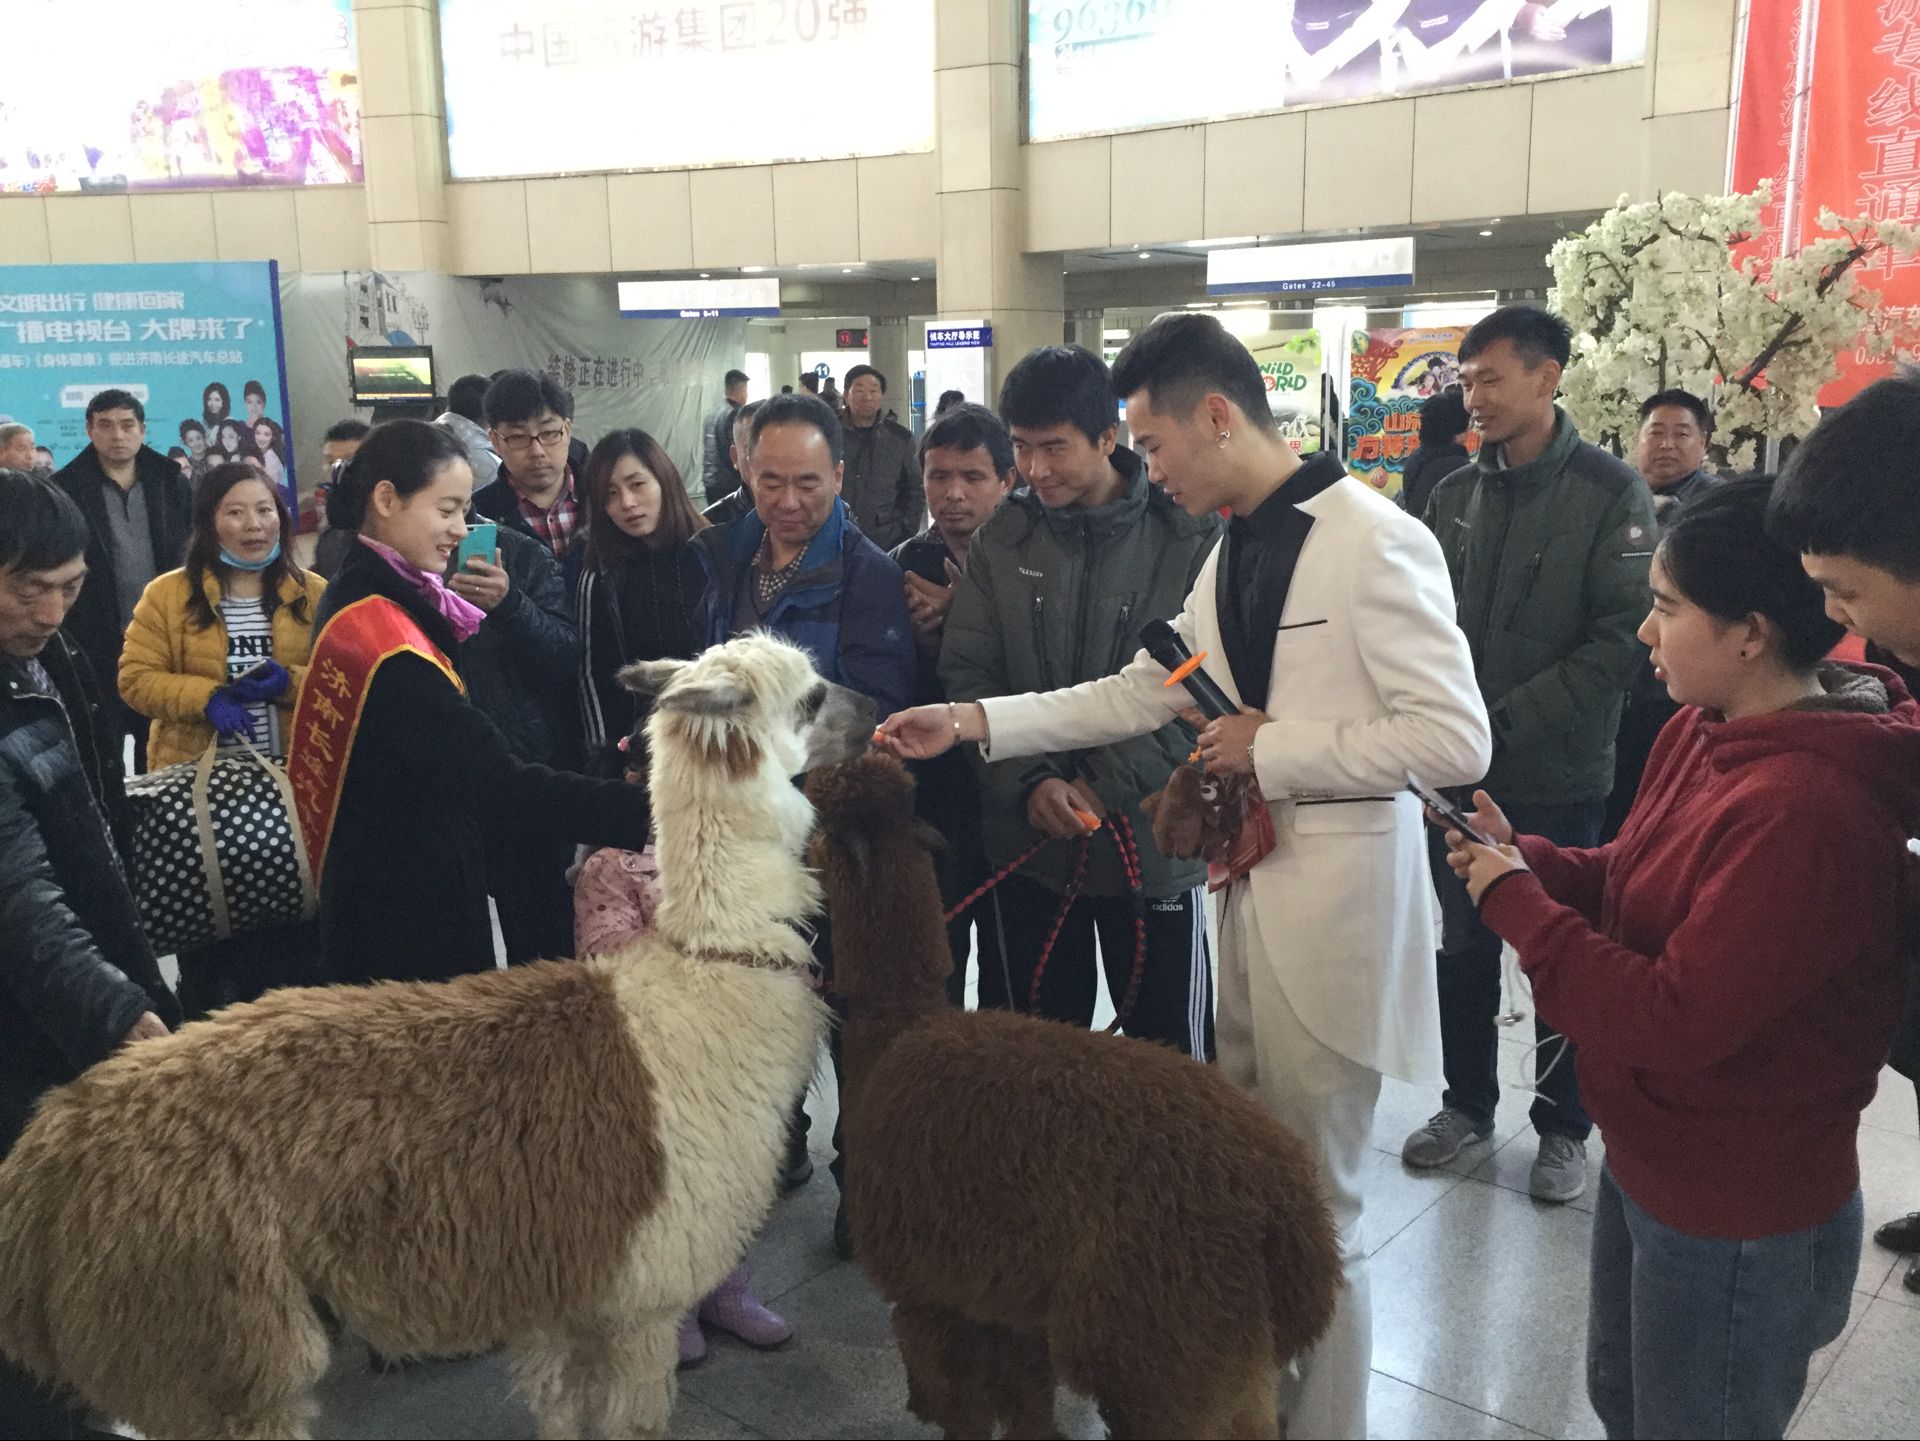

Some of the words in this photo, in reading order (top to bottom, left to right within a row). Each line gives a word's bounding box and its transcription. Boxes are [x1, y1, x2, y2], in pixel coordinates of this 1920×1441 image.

[1282, 282, 1306, 290] Gates
[817, 366, 828, 377] 11
[1152, 903, 1183, 911] adidas
